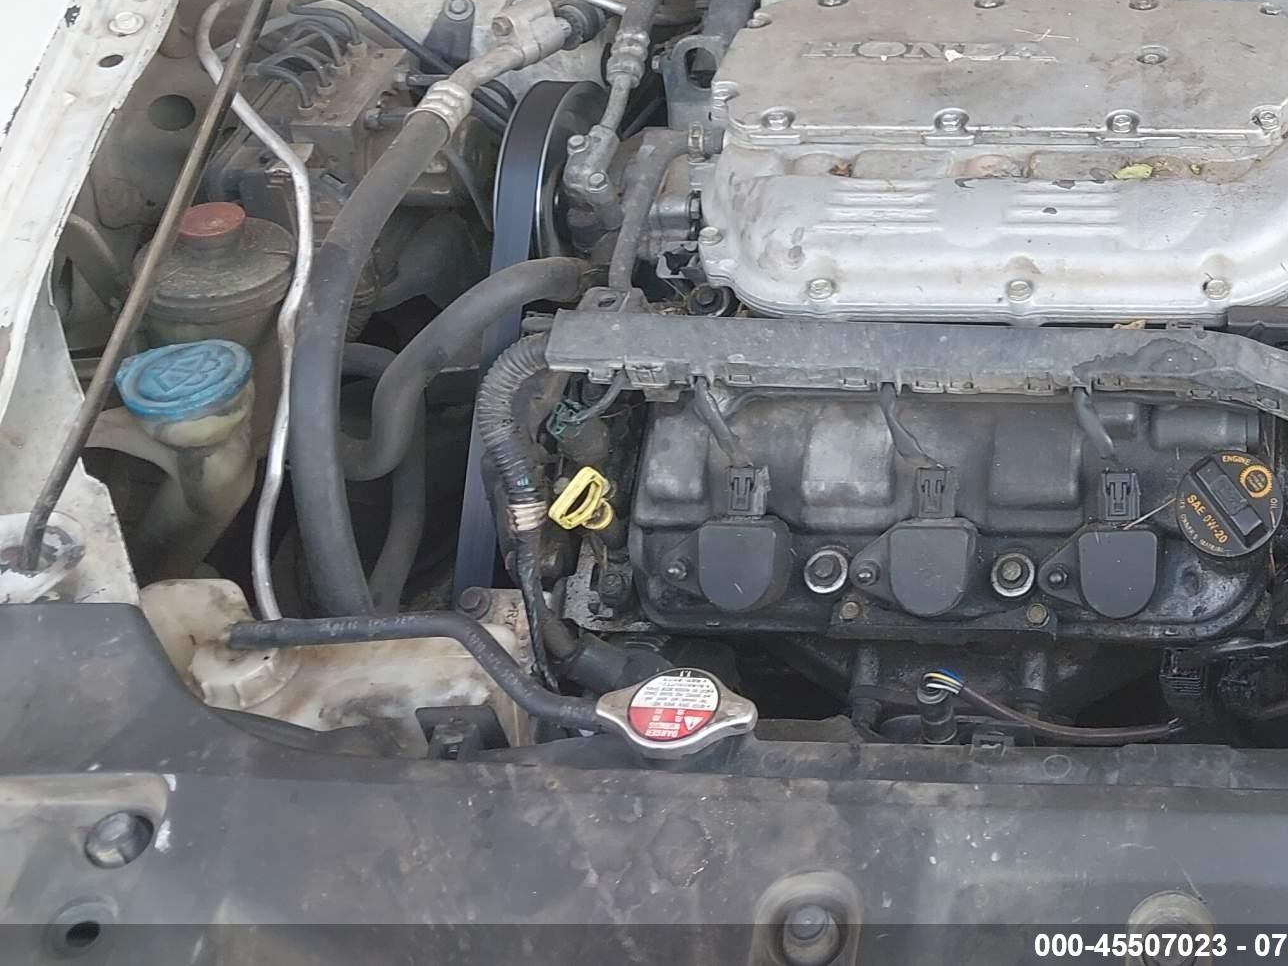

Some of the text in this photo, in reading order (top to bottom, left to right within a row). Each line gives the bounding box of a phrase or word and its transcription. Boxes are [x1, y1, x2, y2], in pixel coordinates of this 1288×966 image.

[801, 40, 1057, 61] HONDA
[1222, 454, 1251, 465] ENGINE
[1187, 494, 1206, 516] SAE
[1203, 514, 1229, 544] 0W-20
